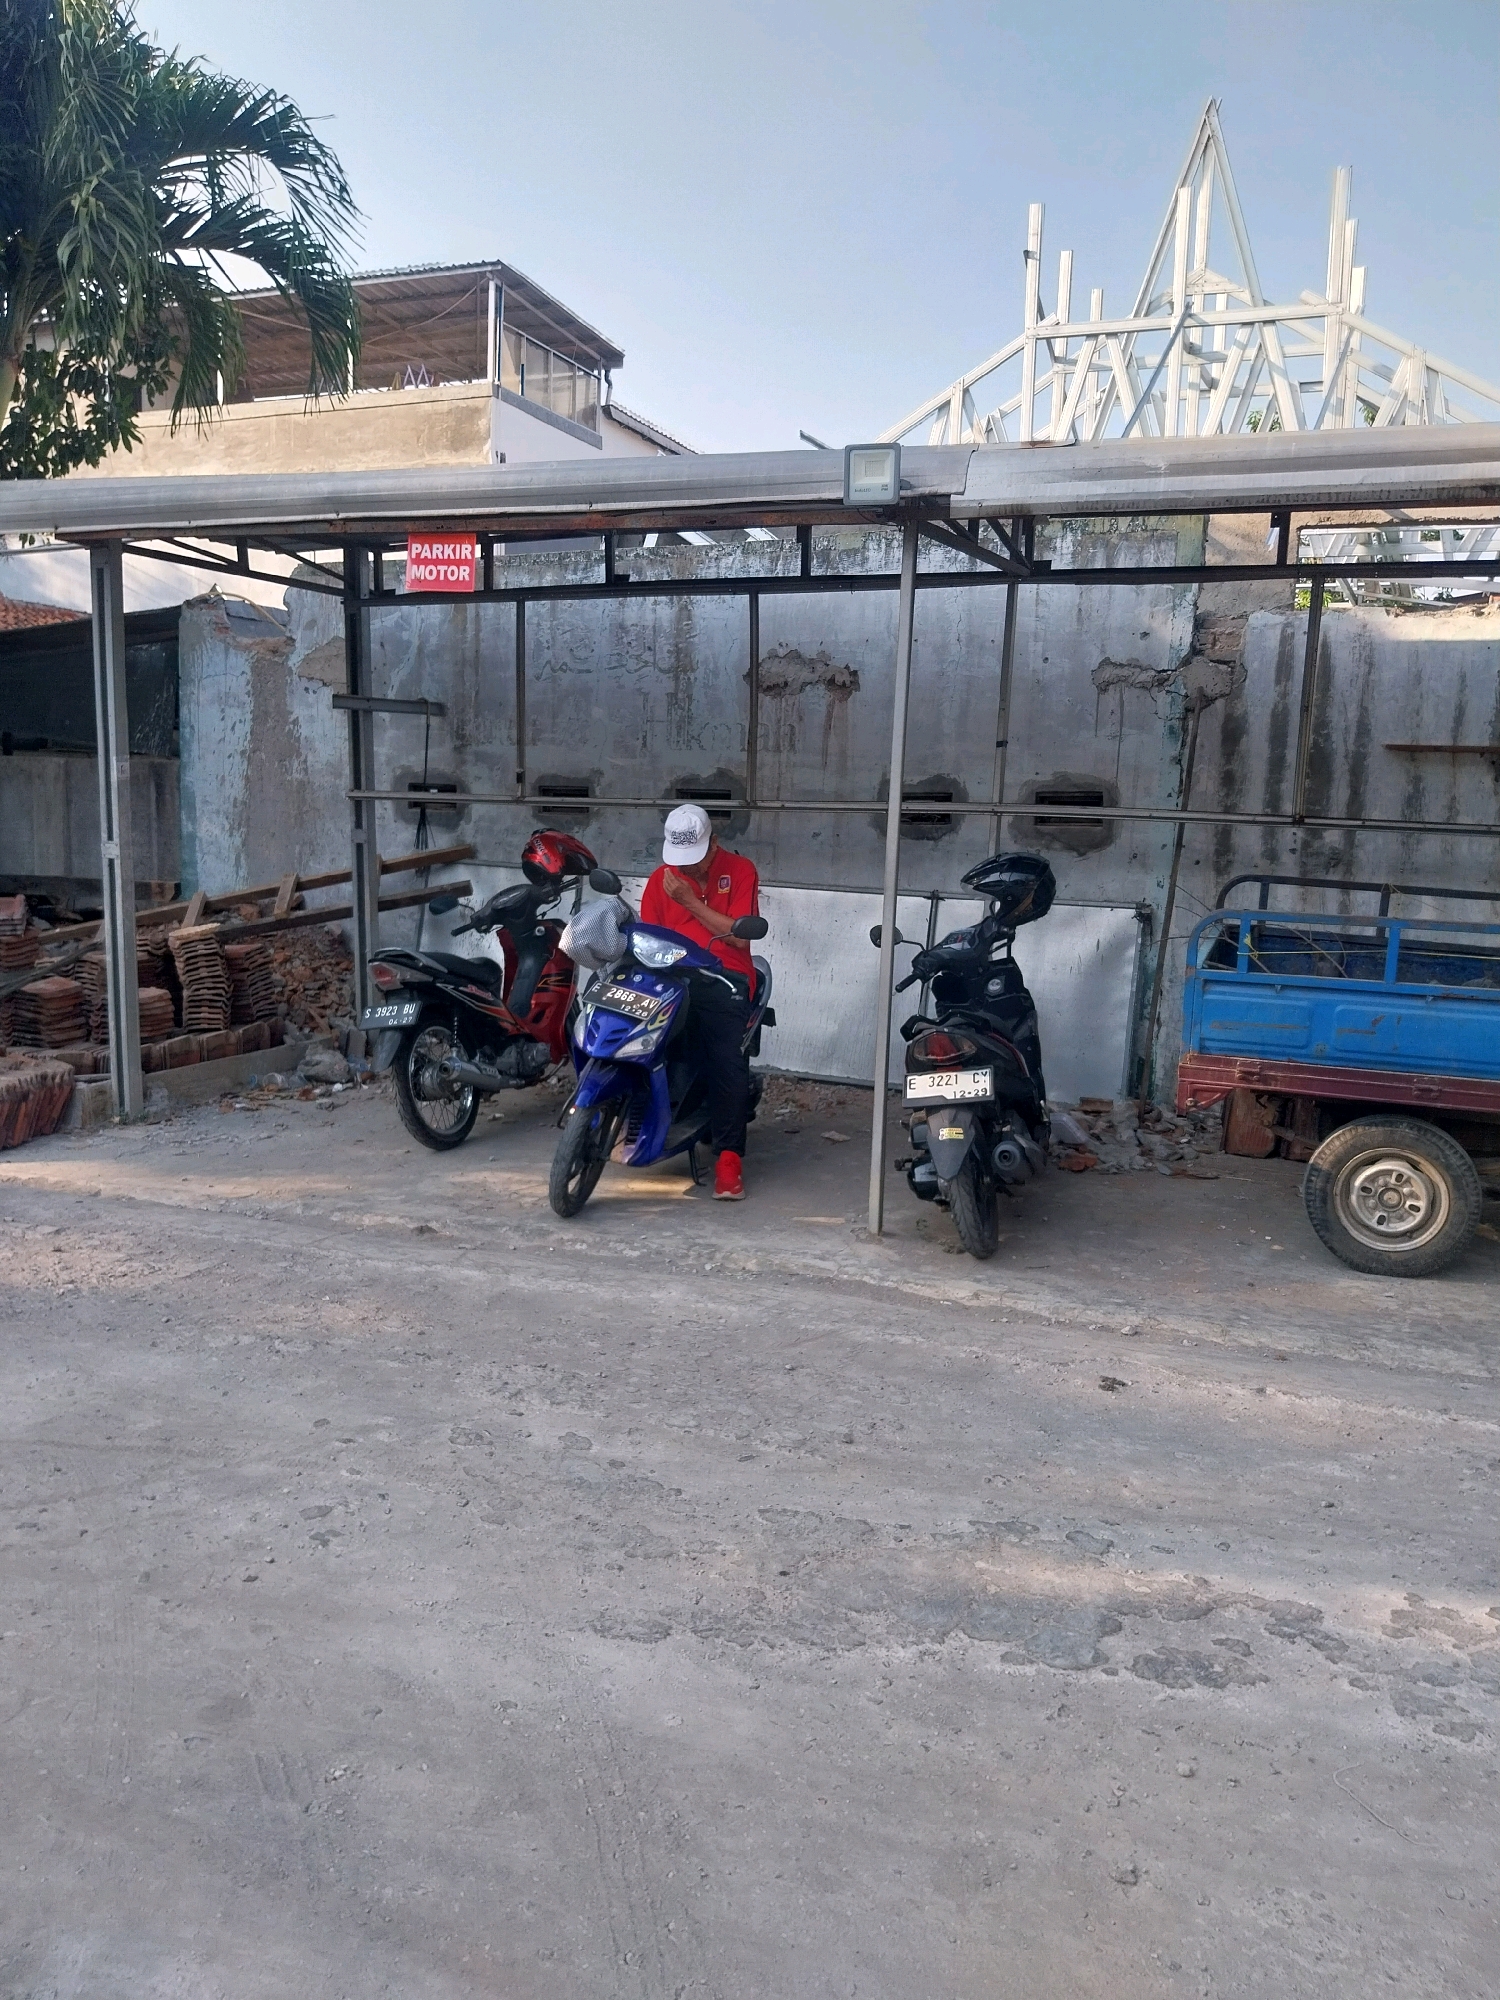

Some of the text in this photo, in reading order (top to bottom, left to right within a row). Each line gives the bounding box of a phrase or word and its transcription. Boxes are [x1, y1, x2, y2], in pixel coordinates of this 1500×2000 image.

[411, 543, 472, 560] PARKIR
[411, 565, 470, 581] MOTOR
[591, 982, 659, 1009] E 2866 AV
[365, 1003, 416, 1019] S 3923 BU
[908, 1070, 988, 1090] E 3221 CY
